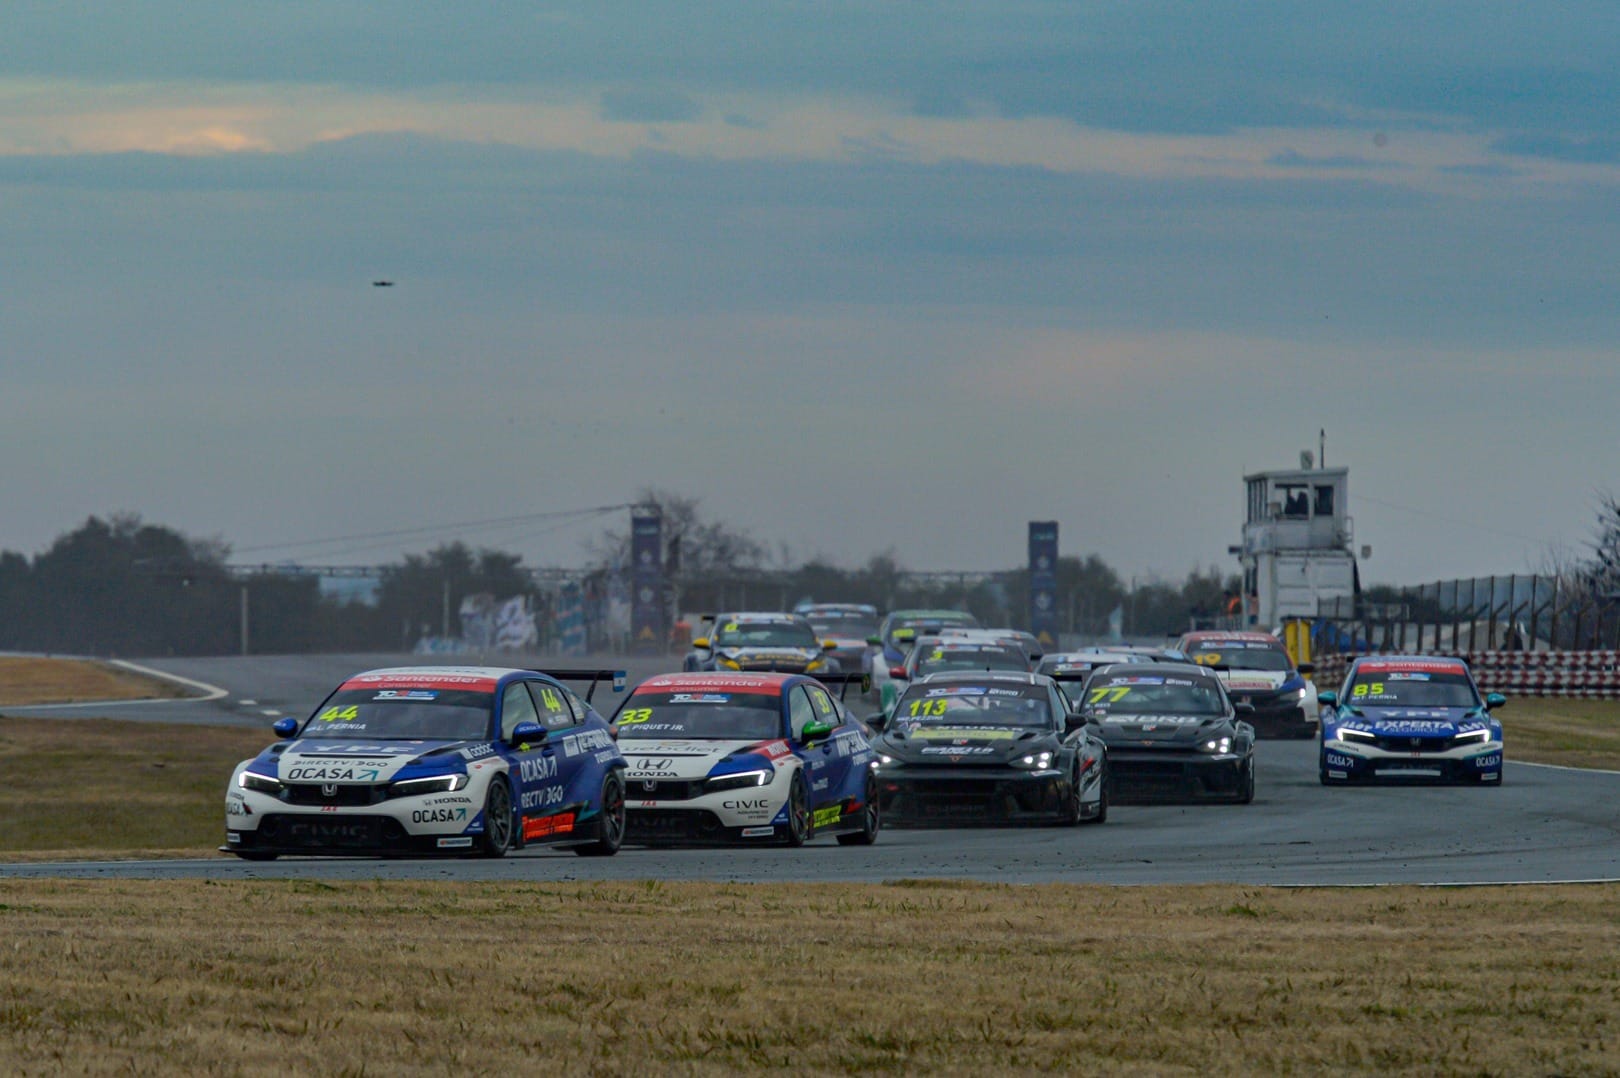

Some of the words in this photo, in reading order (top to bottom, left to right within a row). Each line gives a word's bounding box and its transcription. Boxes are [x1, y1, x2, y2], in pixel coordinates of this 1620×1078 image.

[382, 675, 481, 683] Santander
[675, 679, 764, 687] Santander
[1090, 687, 1131, 703] 77
[1353, 683, 1384, 696] 85
[541, 688, 562, 712] 44
[319, 705, 359, 722] 44
[910, 699, 948, 716] 113
[617, 708, 653, 726] 33
[327, 723, 367, 731] PERNIA
[1375, 721, 1454, 730] EXPERTA
[288, 768, 354, 780] OCASA
[520, 756, 548, 783] OCASA
[723, 800, 768, 809] CIVIC
[412, 809, 455, 823] OCASA
